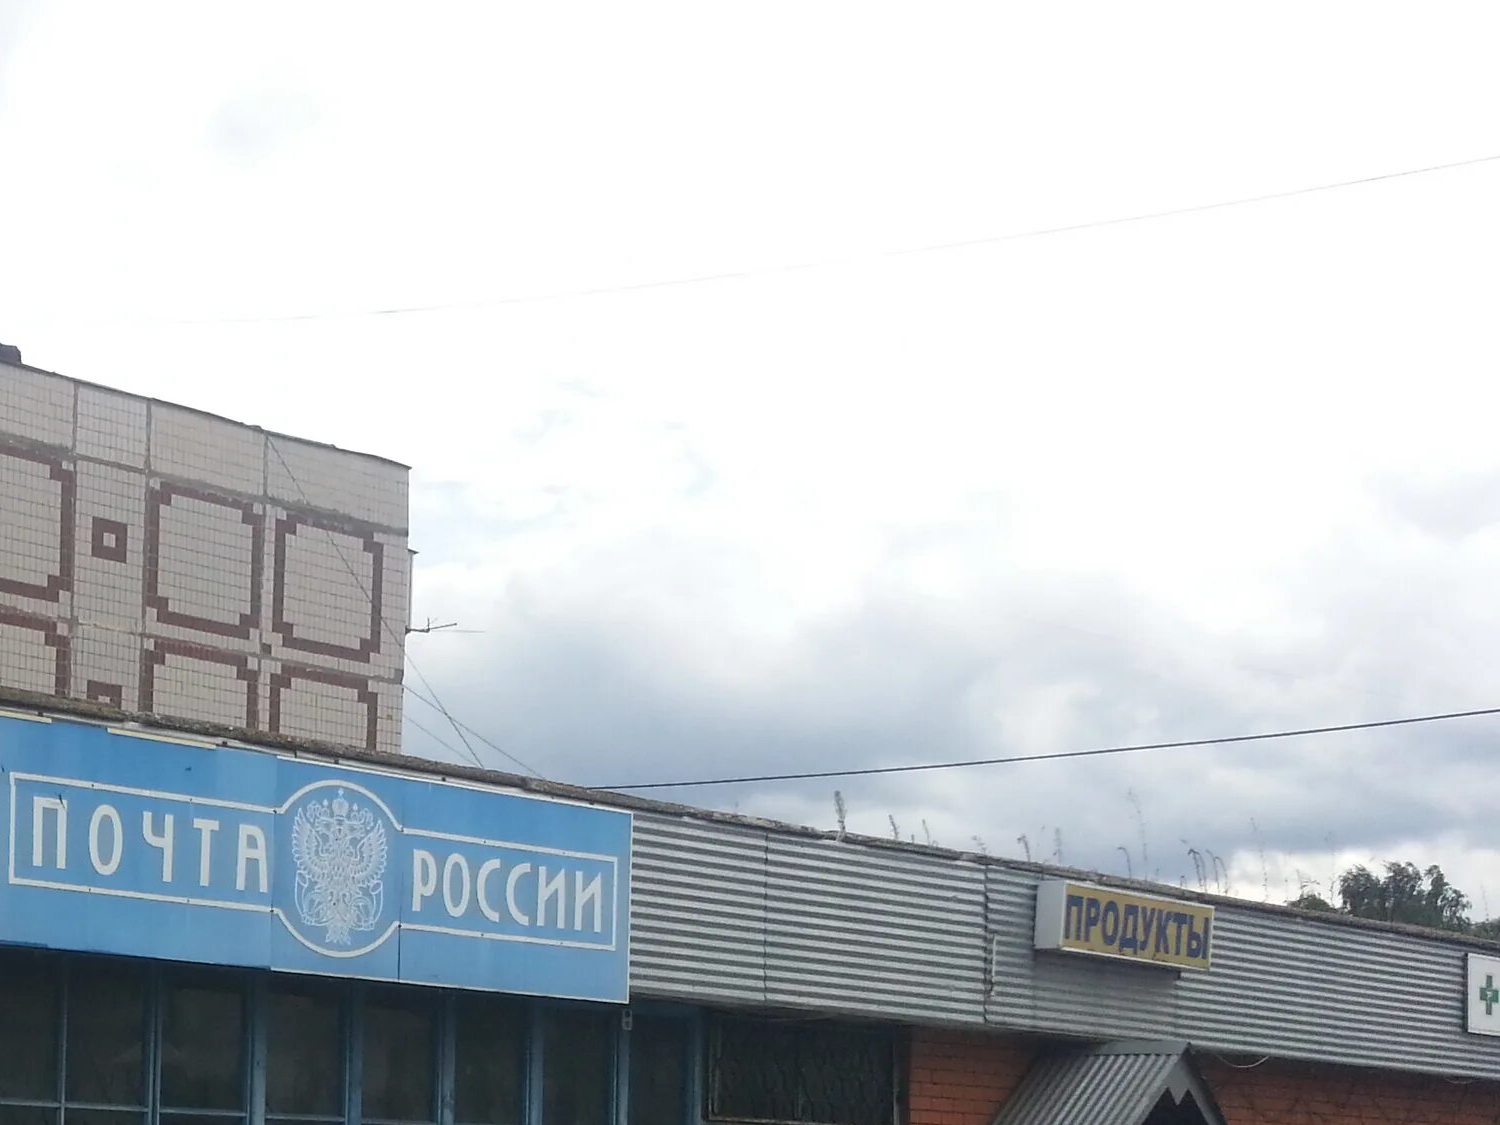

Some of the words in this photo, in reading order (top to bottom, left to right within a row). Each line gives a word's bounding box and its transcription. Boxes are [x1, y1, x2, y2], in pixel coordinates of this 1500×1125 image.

[32, 796, 268, 893] ПОЧТА
[412, 849, 602, 933] РОССИИ
[1064, 895, 1210, 960] ПРОДУКТЫ
